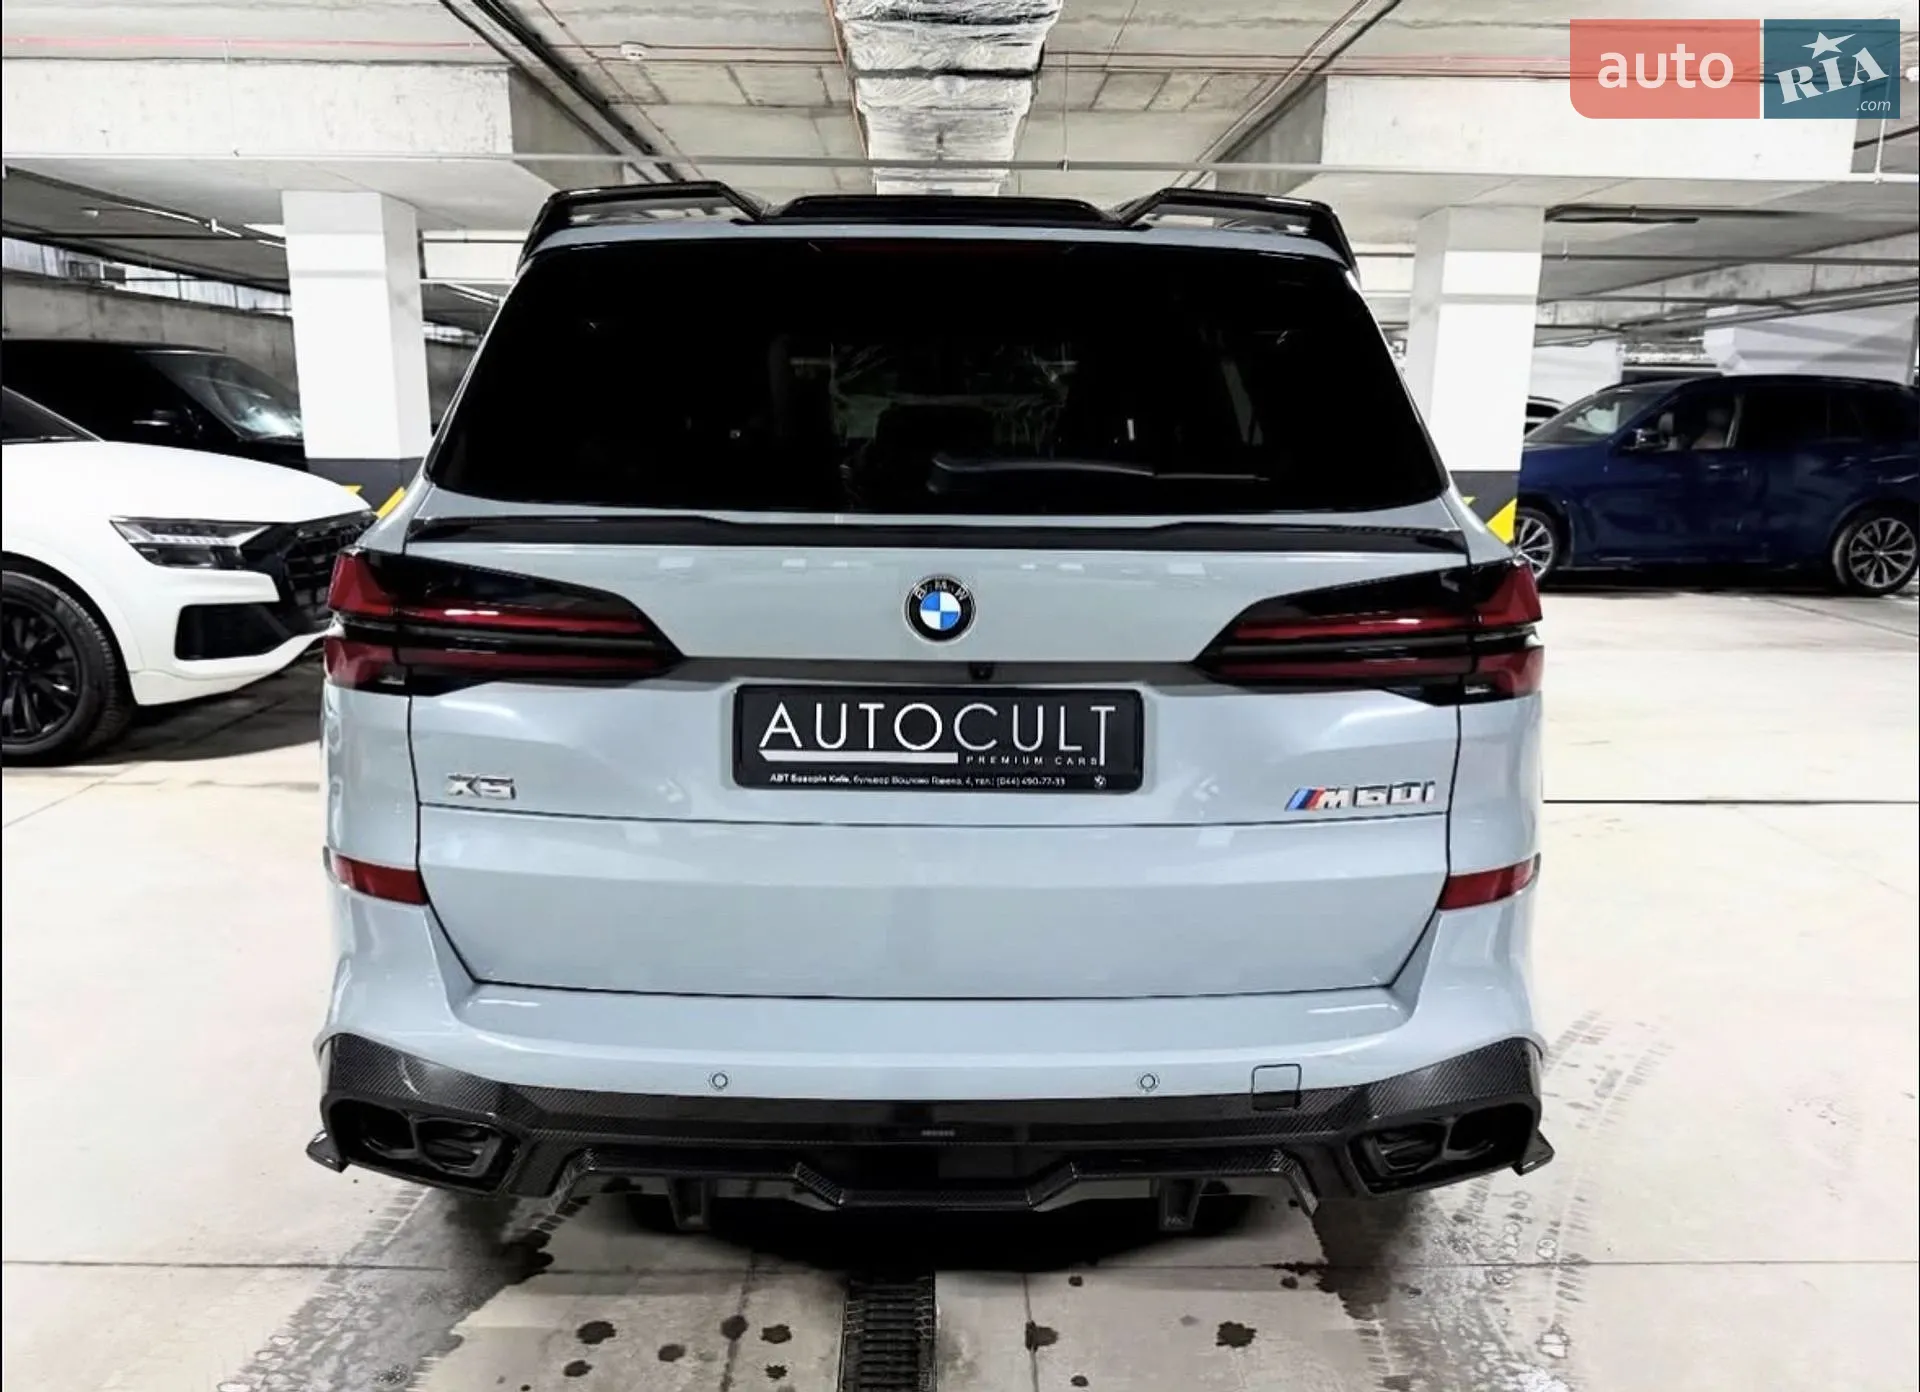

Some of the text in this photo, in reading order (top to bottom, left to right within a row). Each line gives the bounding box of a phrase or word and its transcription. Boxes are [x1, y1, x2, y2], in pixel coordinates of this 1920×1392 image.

[911, 579, 969, 601] BMW
[759, 701, 1116, 766] AUTOCULT
[966, 755, 1098, 766] PREMIUM CARS
[446, 772, 515, 800] X5
